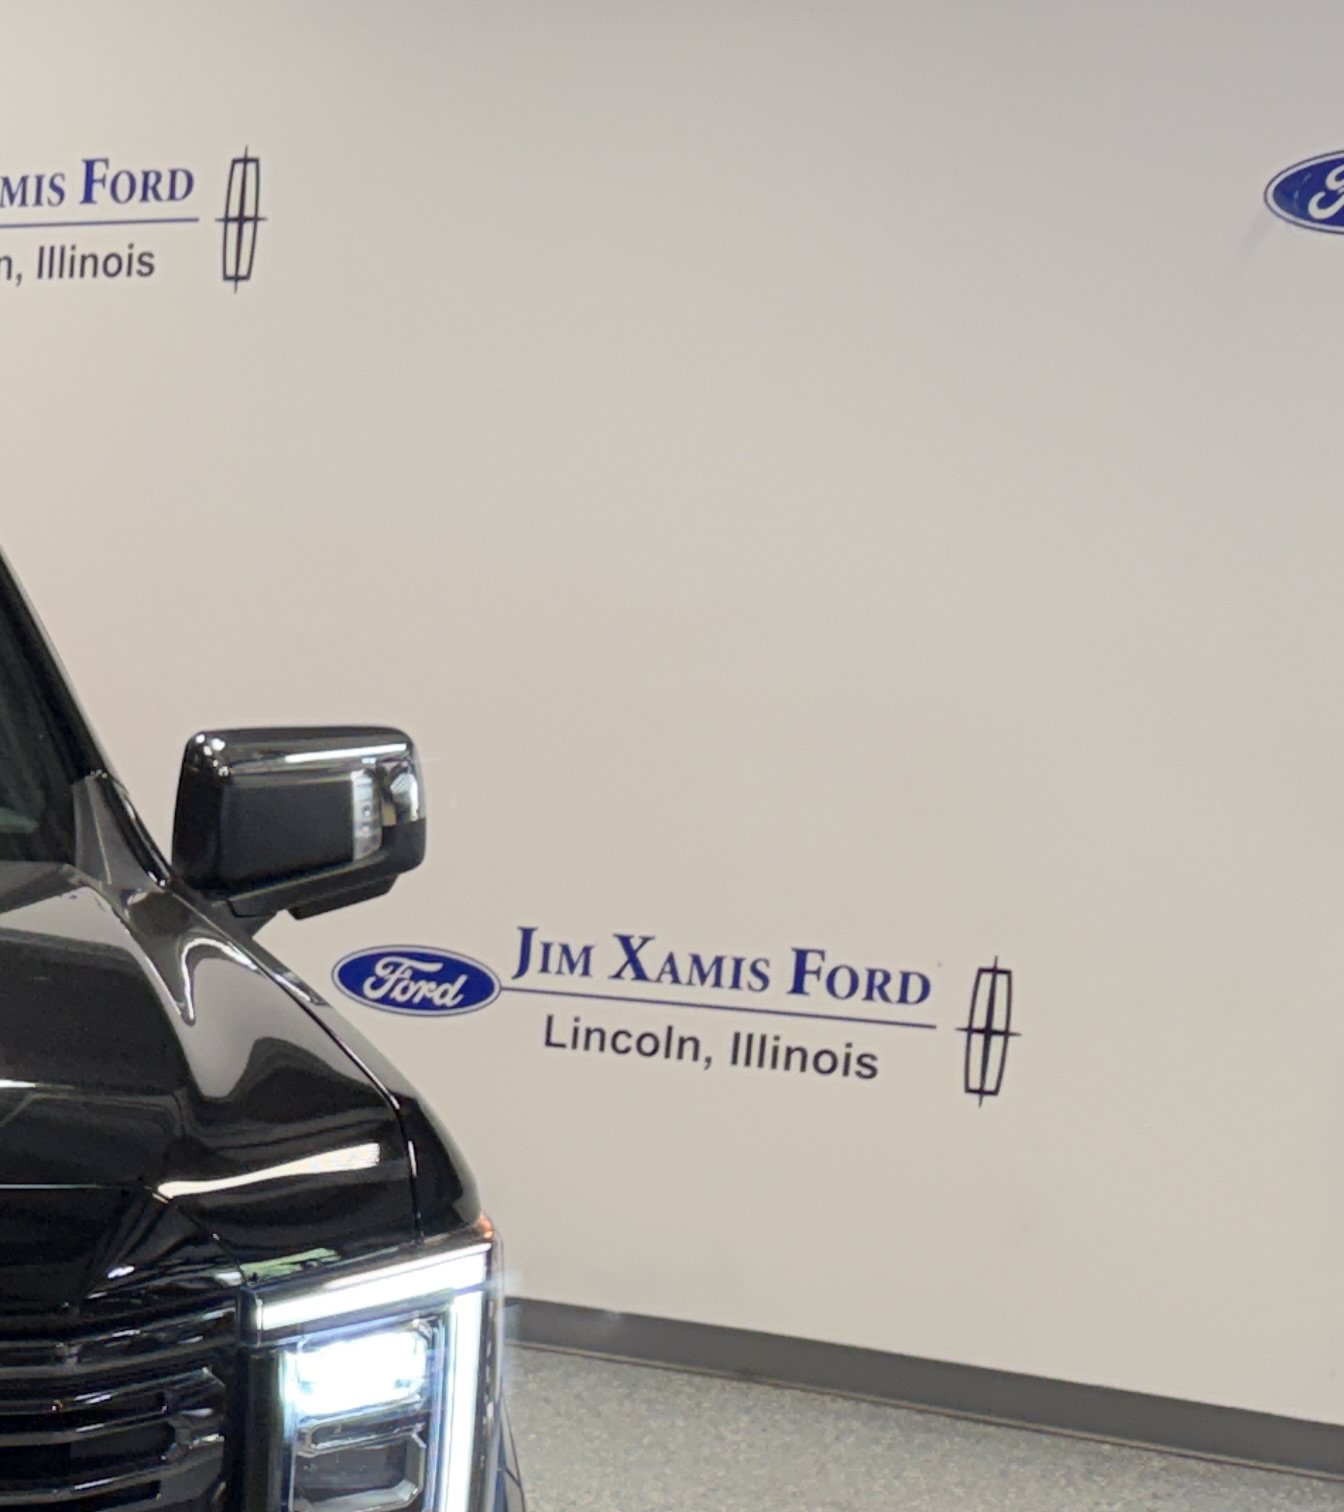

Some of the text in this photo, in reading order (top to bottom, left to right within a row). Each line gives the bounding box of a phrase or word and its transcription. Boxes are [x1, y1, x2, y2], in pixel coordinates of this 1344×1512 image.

[80, 158, 194, 205] FORD
[37, 243, 156, 279] Illinois
[362, 961, 466, 1009] Ford
[511, 926, 932, 1006] JIM XAMIS FORD
[544, 1014, 879, 1080] Lincoln, Illinois
